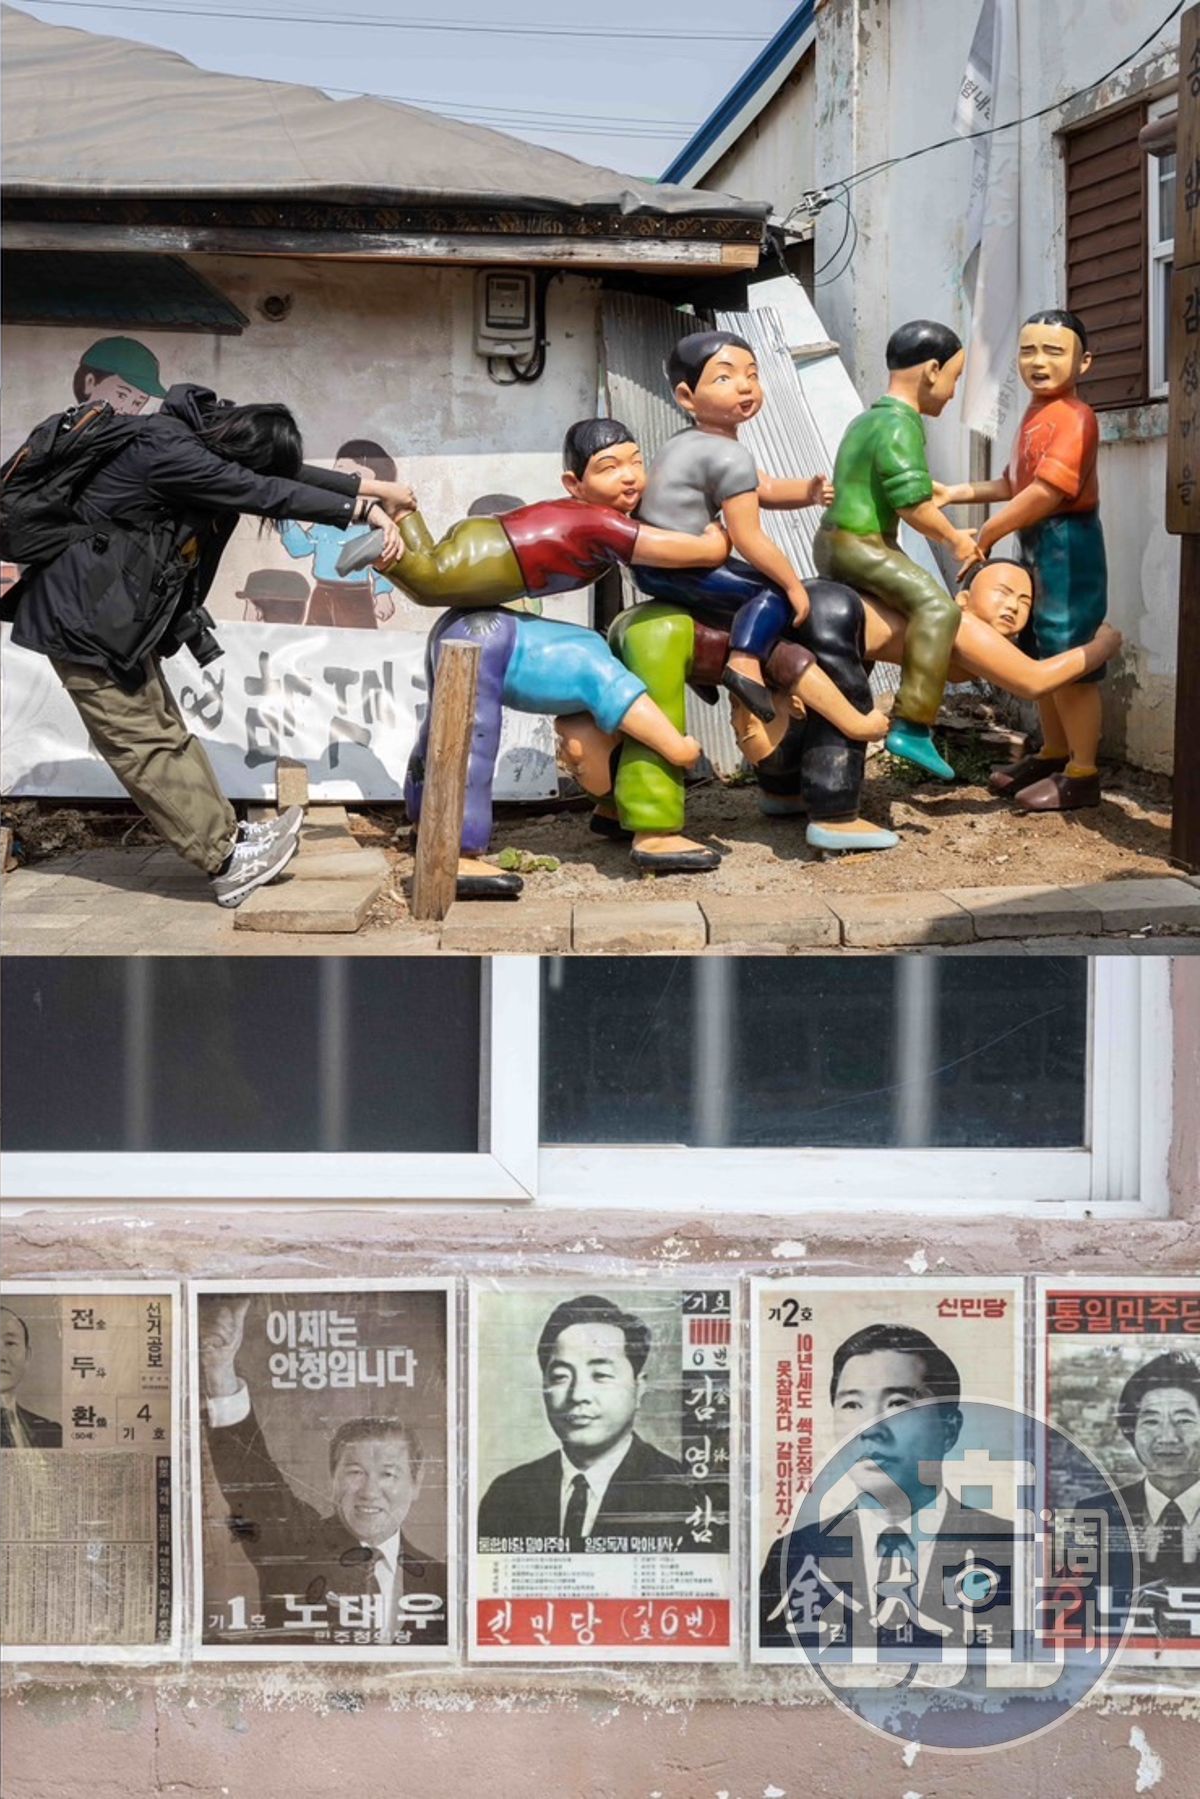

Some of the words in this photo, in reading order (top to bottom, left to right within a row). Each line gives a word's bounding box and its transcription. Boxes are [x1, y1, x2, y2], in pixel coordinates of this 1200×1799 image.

[936, 1297, 1007, 1318] 신민당
[146, 1302, 163, 1368] 선거공보
[266, 1310, 358, 1348] 이제는
[268, 1349, 419, 1390] 안정입니다
[136, 1403, 152, 1423] 4
[775, 1360, 792, 1432] 못참겠다
[282, 1593, 445, 1630] 노태우
